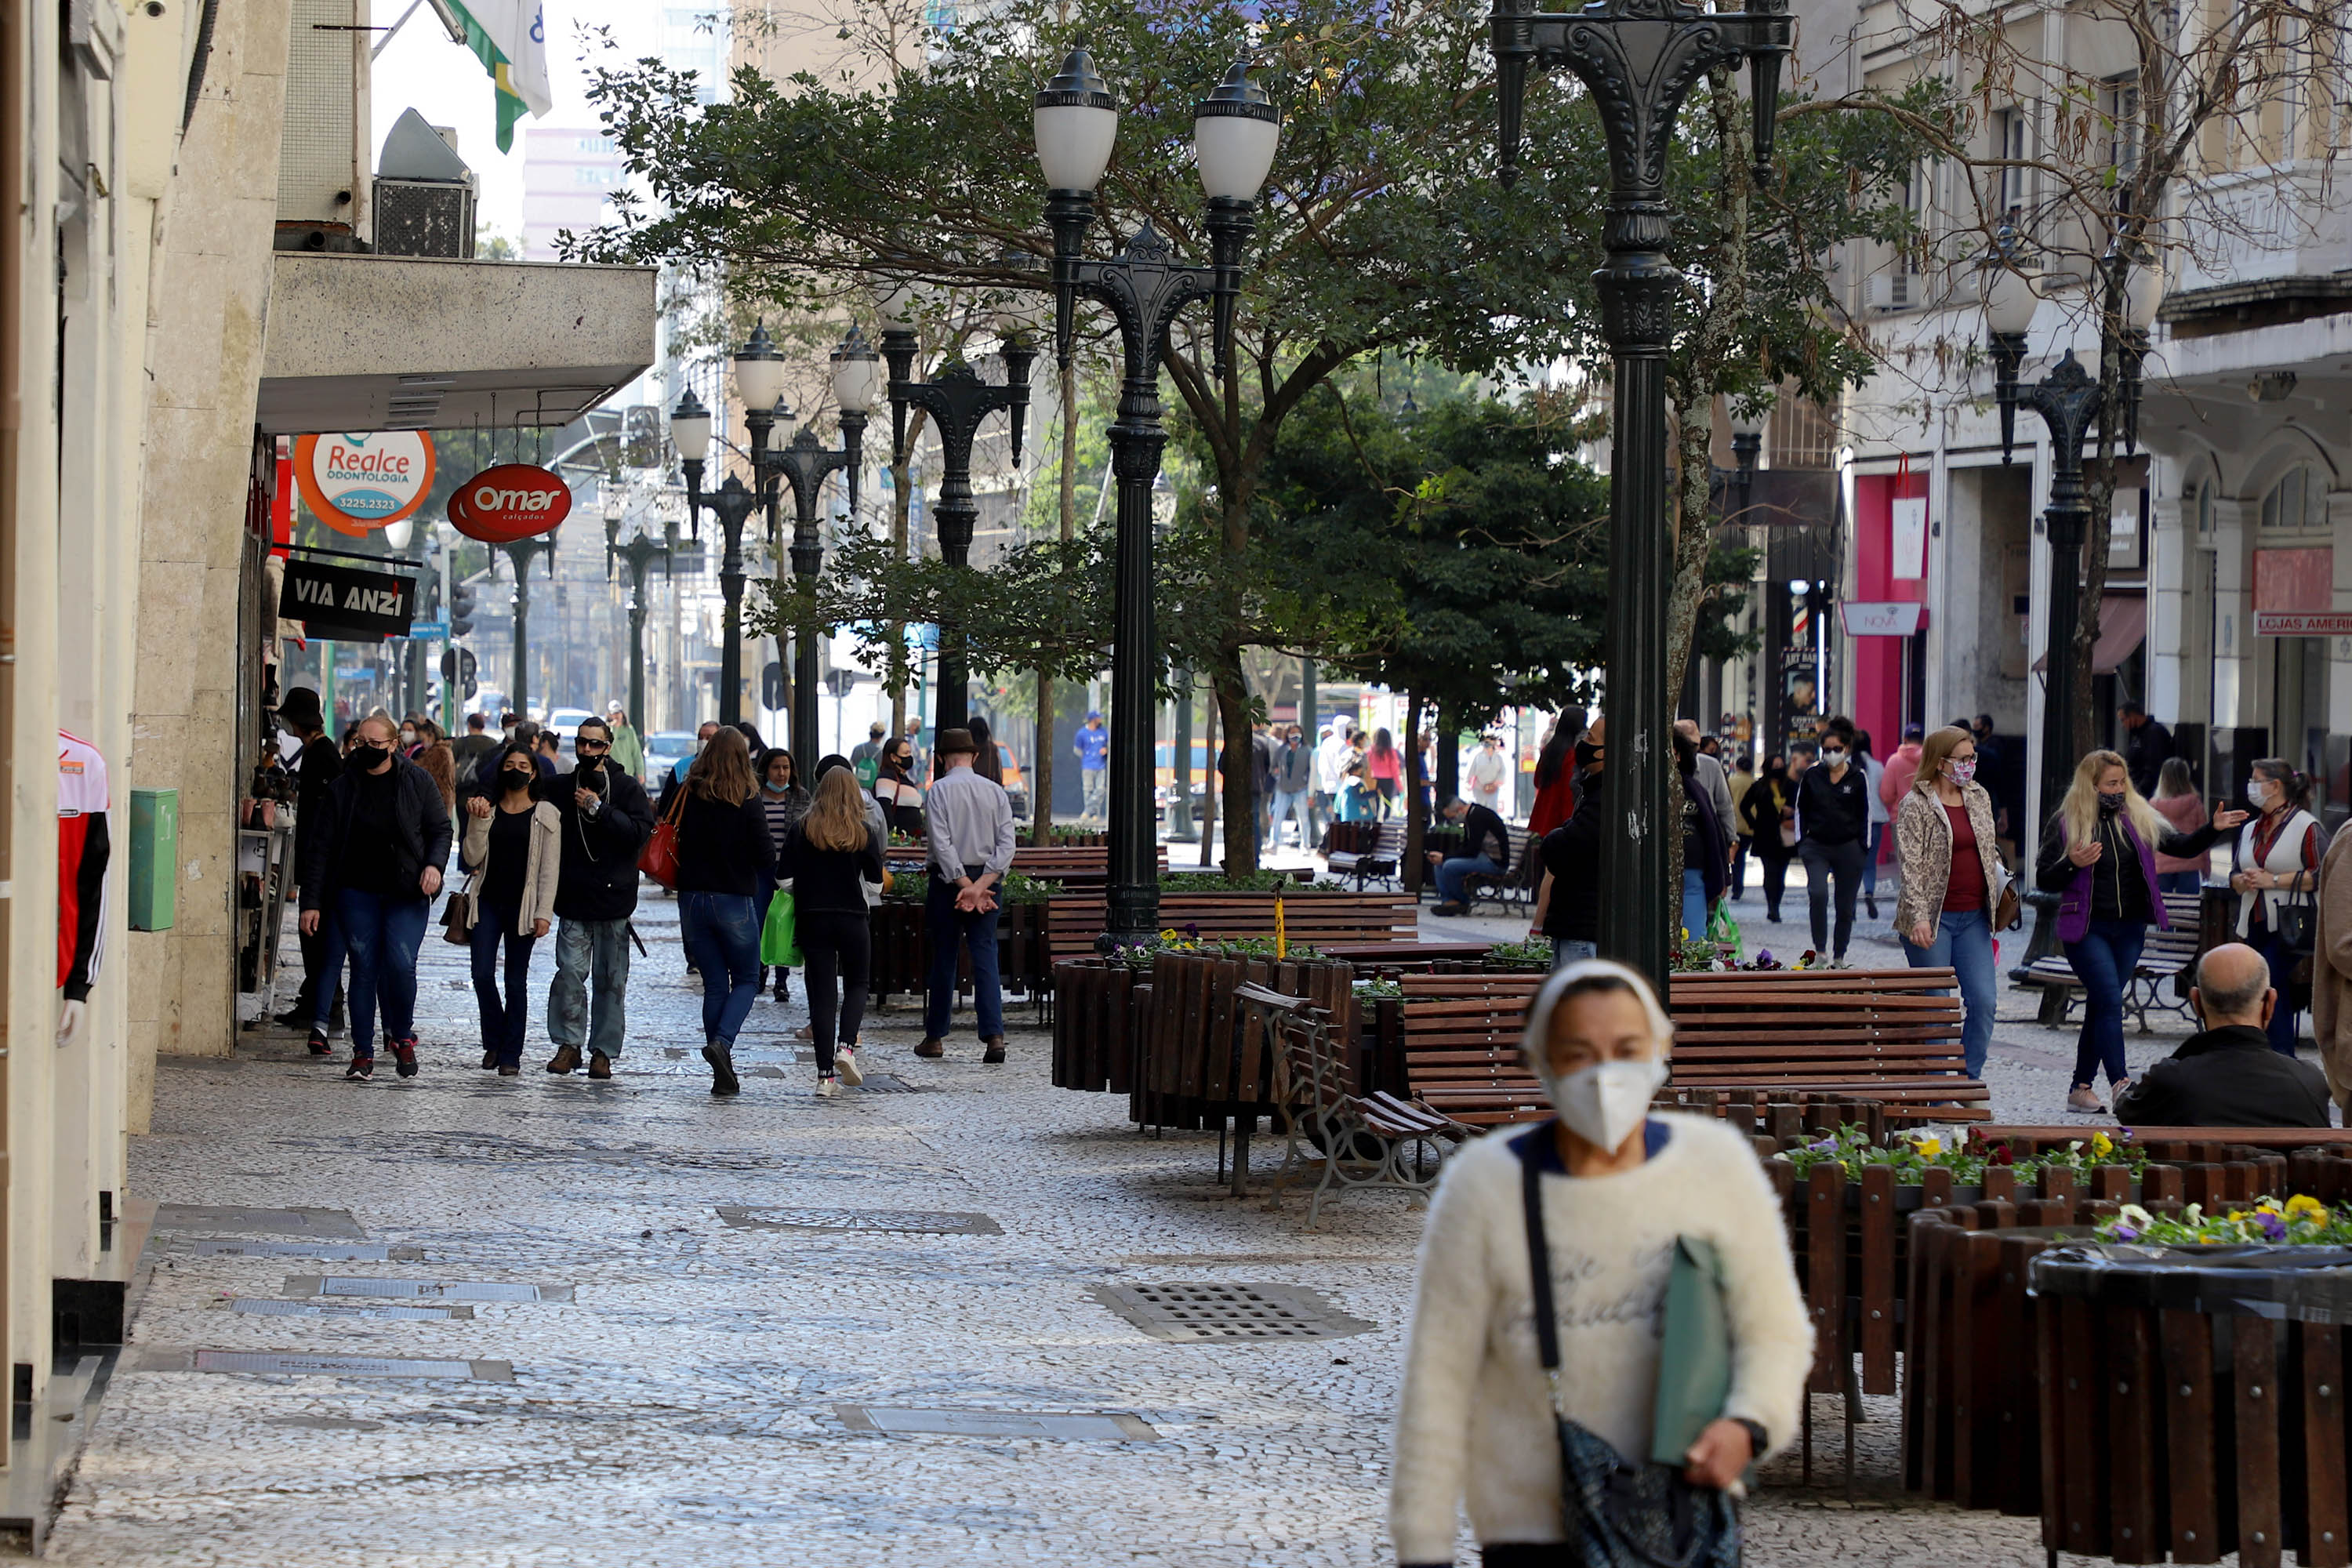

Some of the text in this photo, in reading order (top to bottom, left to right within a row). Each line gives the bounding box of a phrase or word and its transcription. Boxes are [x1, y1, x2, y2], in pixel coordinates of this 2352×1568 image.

[328, 445, 409, 474] Realce
[327, 470, 408, 483] ODONTOLOGIA
[339, 497, 395, 510] 3225.2323
[296, 578, 403, 617] VIA ANZI
[2259, 619, 2303, 630] LOJAS
